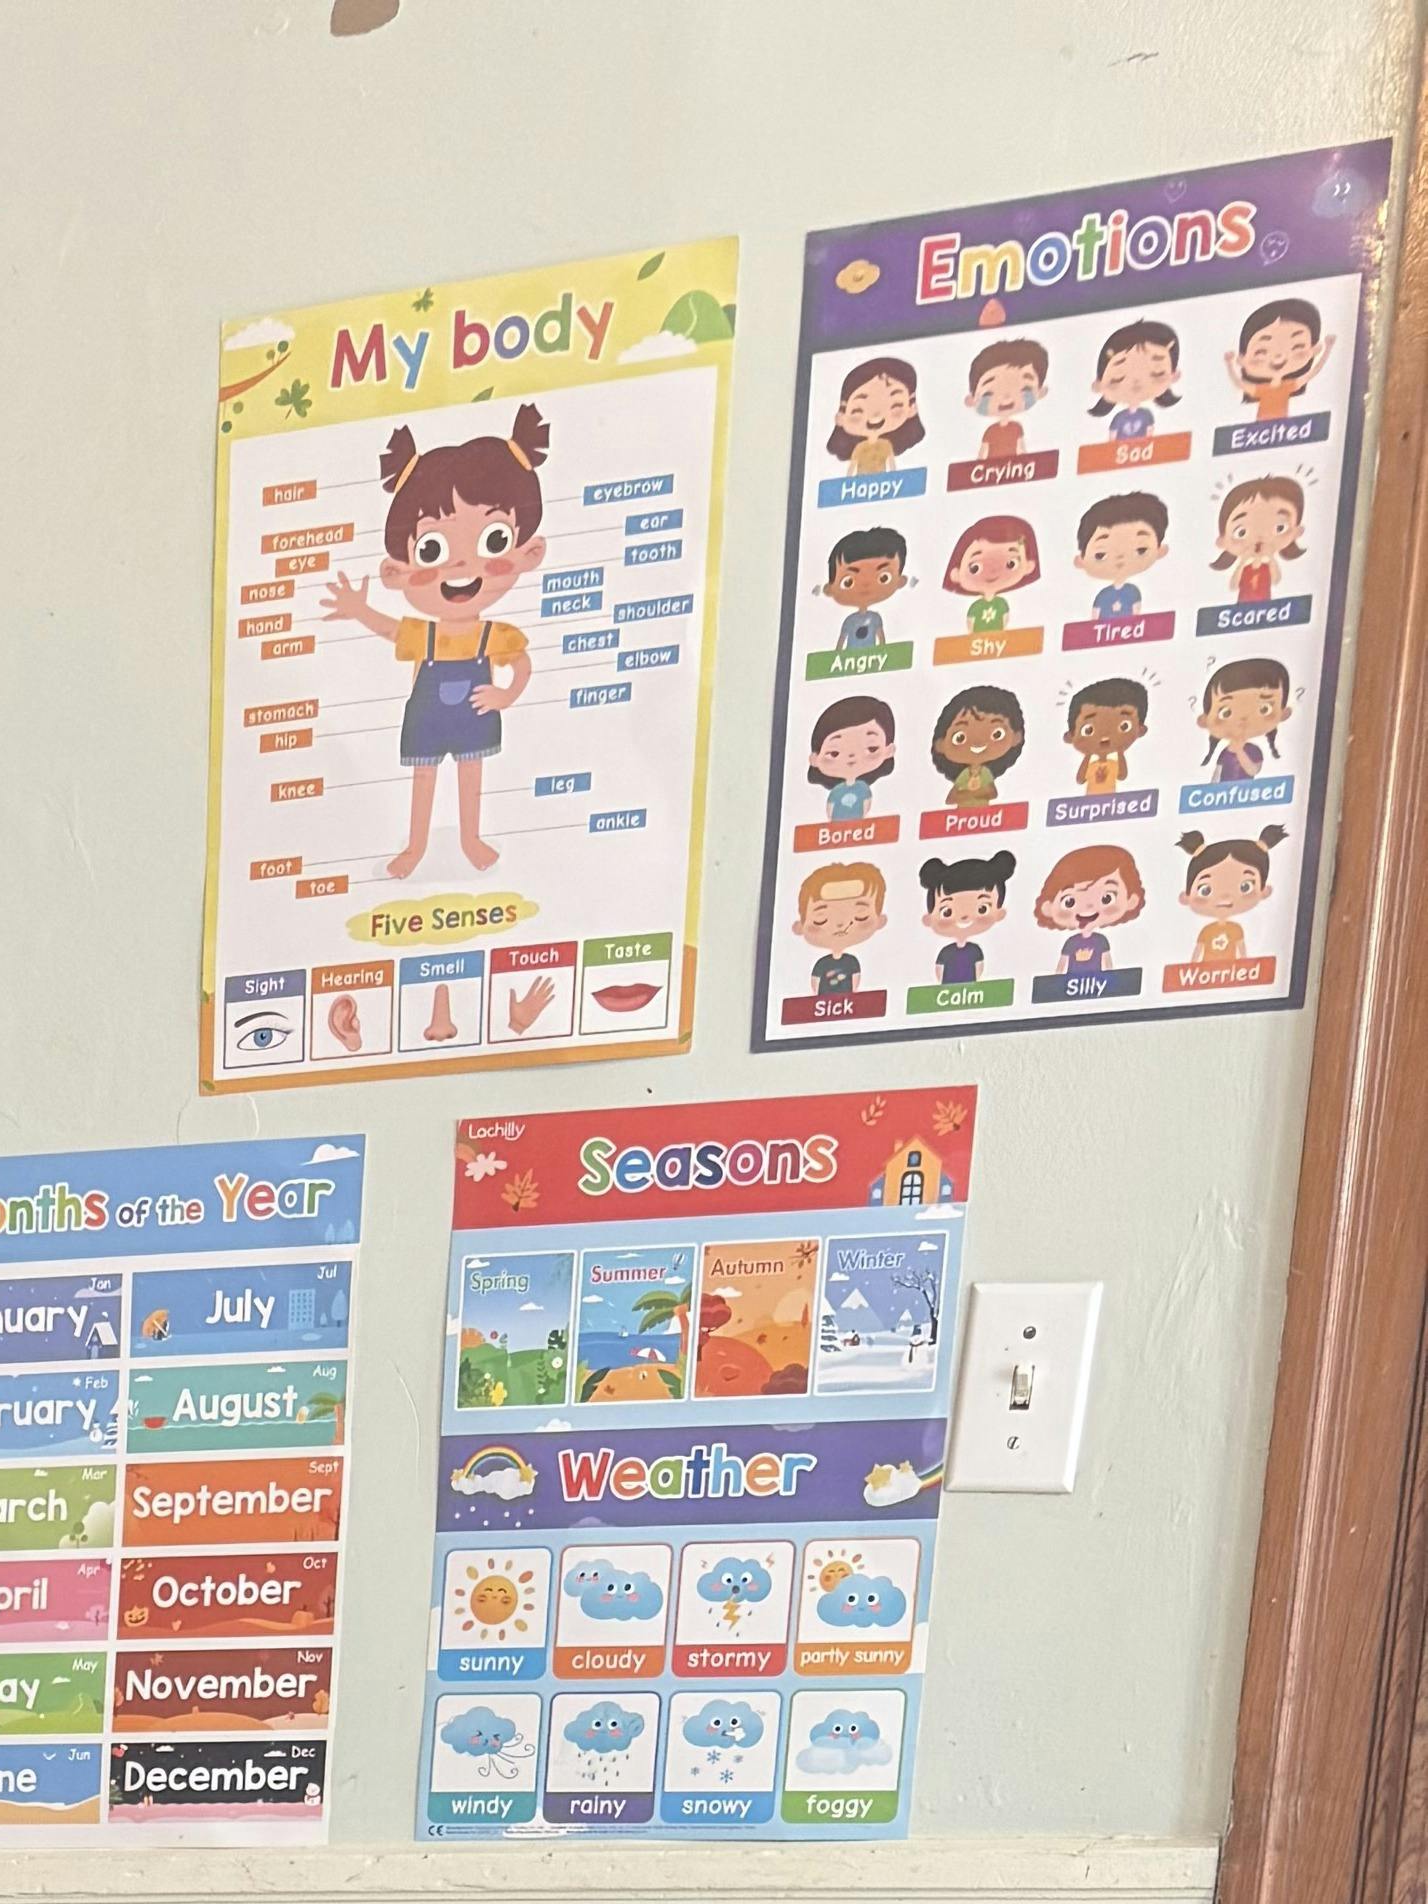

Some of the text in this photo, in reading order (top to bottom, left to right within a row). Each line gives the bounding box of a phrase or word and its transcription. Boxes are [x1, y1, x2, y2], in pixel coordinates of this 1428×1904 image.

[914, 198, 1257, 307] Emotions
[329, 291, 615, 394] My body
[1231, 421, 1312, 449] Excited
[970, 460, 1035, 484] Crying
[594, 479, 663, 502] eyebrow
[841, 477, 904, 499] Happy
[640, 514, 668, 530] ear
[271, 527, 344, 549] forehead
[288, 556, 316, 571] eye
[546, 571, 599, 591] mouth
[246, 619, 283, 634] hand
[1218, 603, 1292, 628] Scared
[1093, 620, 1145, 642] Tired
[829, 651, 887, 672] Angry
[575, 686, 626, 707] finger
[278, 782, 315, 797] knee
[1187, 783, 1285, 807] Confused
[1055, 795, 1152, 820] Surprised
[596, 814, 640, 831] ankle
[945, 811, 1002, 832] Proud
[817, 824, 875, 845] Bored
[371, 906, 518, 937] Five Senses
[509, 948, 559, 966] Touch
[605, 942, 652, 959] Taste
[321, 968, 384, 989] Hearing
[420, 960, 464, 978] Smell
[1178, 964, 1261, 985] Worried
[245, 976, 285, 996] Sight
[1066, 977, 1107, 998] Silly
[468, 1121, 526, 1141] Lachilly
[578, 1133, 837, 1196] Seasons
[117, 1196, 152, 1229] of
[155, 1194, 204, 1226] the
[213, 1171, 335, 1224] Year
[710, 1258, 784, 1276] Autumn
[837, 1250, 904, 1270] Winter
[317, 1265, 337, 1279] Jul
[590, 1265, 667, 1284] Summer
[471, 1272, 529, 1295] Spring
[205, 1289, 275, 1329] July
[172, 1385, 298, 1428] August
[558, 1443, 817, 1503] Weather
[132, 1481, 332, 1523] September
[152, 1574, 302, 1608] October
[459, 1652, 524, 1675] sunny
[571, 1651, 646, 1674] cloudy
[687, 1647, 771, 1671] stormy
[800, 1648, 905, 1667] partly sunny
[125, 1667, 318, 1701] November
[291, 1746, 315, 1758] Dec
[123, 1760, 309, 1792] December
[451, 1796, 513, 1820] windy
[570, 1796, 627, 1820] rainy
[682, 1797, 751, 1819] snowy
[806, 1795, 873, 1820] foggy
